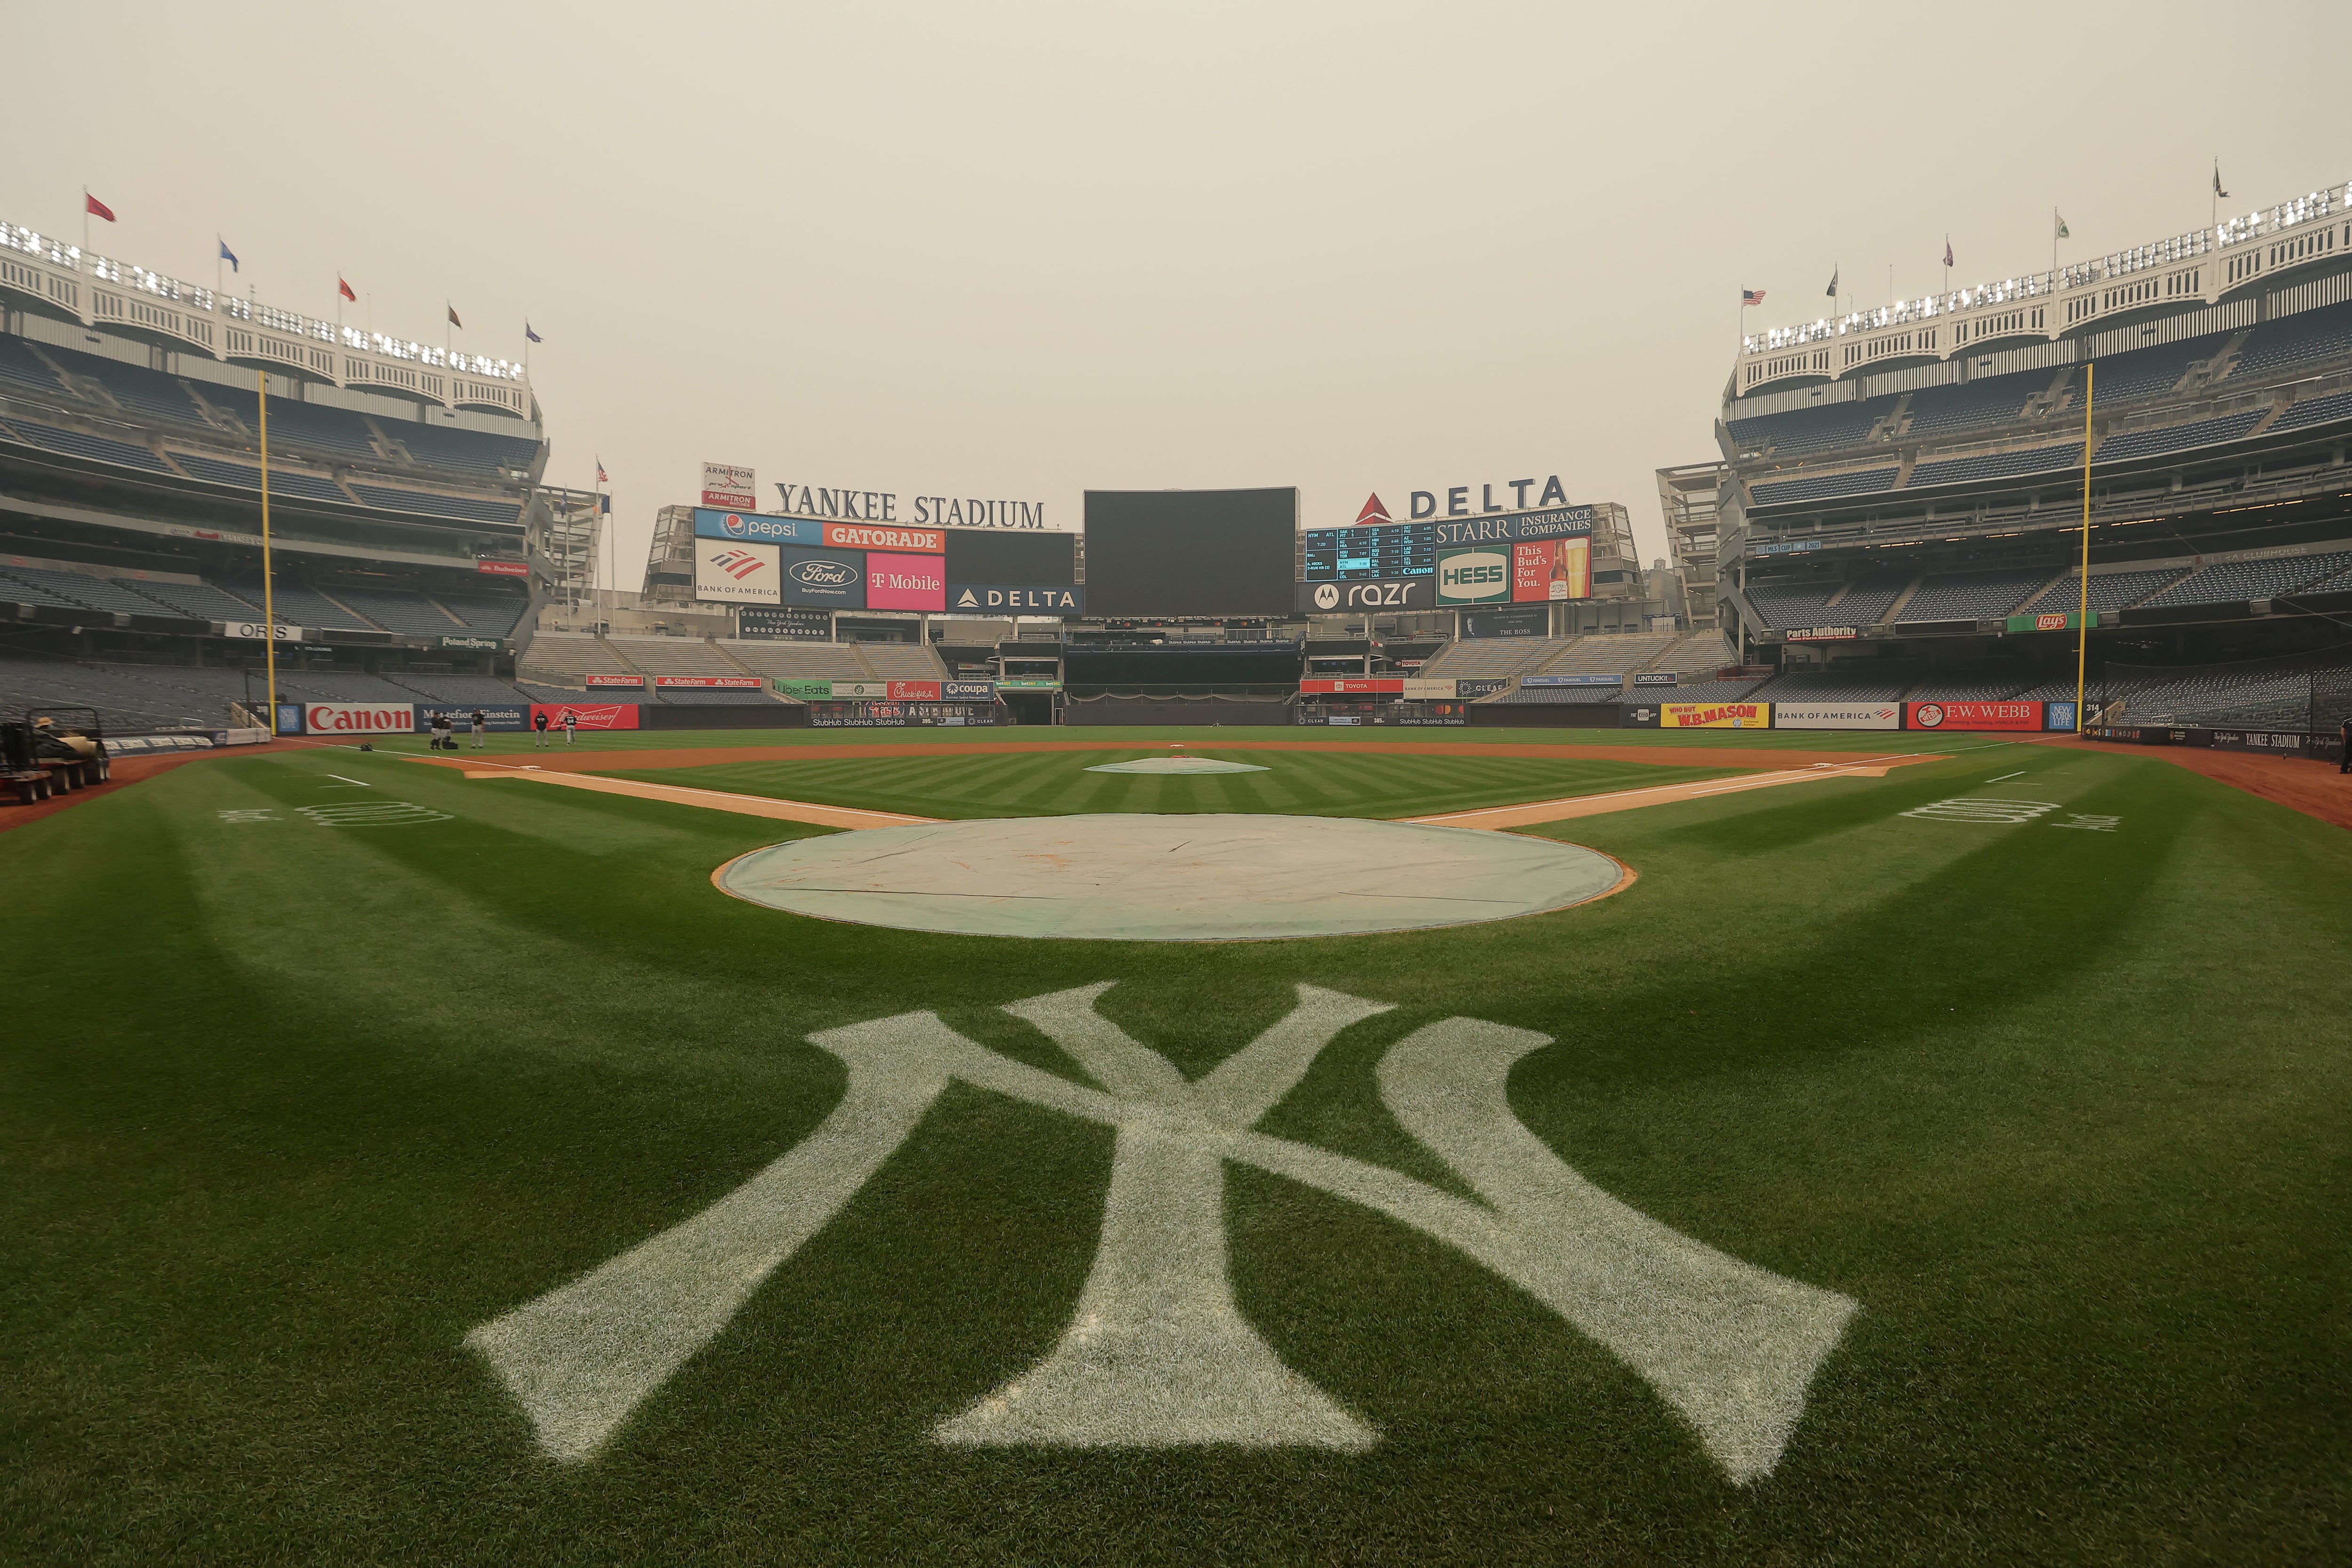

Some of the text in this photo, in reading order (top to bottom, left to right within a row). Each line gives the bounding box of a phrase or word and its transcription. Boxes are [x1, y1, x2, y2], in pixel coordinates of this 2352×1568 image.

[706, 467, 753, 478] ARMITRON
[708, 493, 750, 503] ARMITRON
[1411, 475, 1567, 519] DELTA
[774, 483, 1044, 529] YANKEE STADIUM
[1521, 509, 1591, 526] INSURANCE
[748, 521, 798, 538] pepsi
[1436, 519, 1512, 543] STARR
[1521, 519, 1591, 536] COMPANIES
[831, 527, 937, 549] GATORADE
[1517, 545, 1542, 556] This
[1517, 556, 1547, 566] Bud's
[801, 564, 846, 583] Ford
[1444, 565, 1503, 585] HESS
[1517, 567, 1536, 577] For
[889, 573, 940, 590] Mobile
[1517, 578, 1541, 588] You.
[738, 587, 778, 596] AMERICA
[988, 590, 1075, 607] DELTA
[1348, 582, 1416, 607] razr
[2038, 615, 2065, 629] Lay's
[240, 624, 287, 638] ORS
[1787, 626, 1857, 637] Parts Authority
[442, 637, 497, 649] Poland Spring
[778, 685, 829, 694] Uber Eats
[959, 685, 988, 695] coupa
[479, 709, 520, 718] Einstein
[556, 711, 615, 722] Bdweiser
[1923, 710, 1939, 720] WEBB
[1980, 705, 2030, 717] WEBB
[309, 706, 412, 731] Canon
[2246, 733, 2268, 746] YANKEE
[2271, 734, 2300, 748] STADIUM
